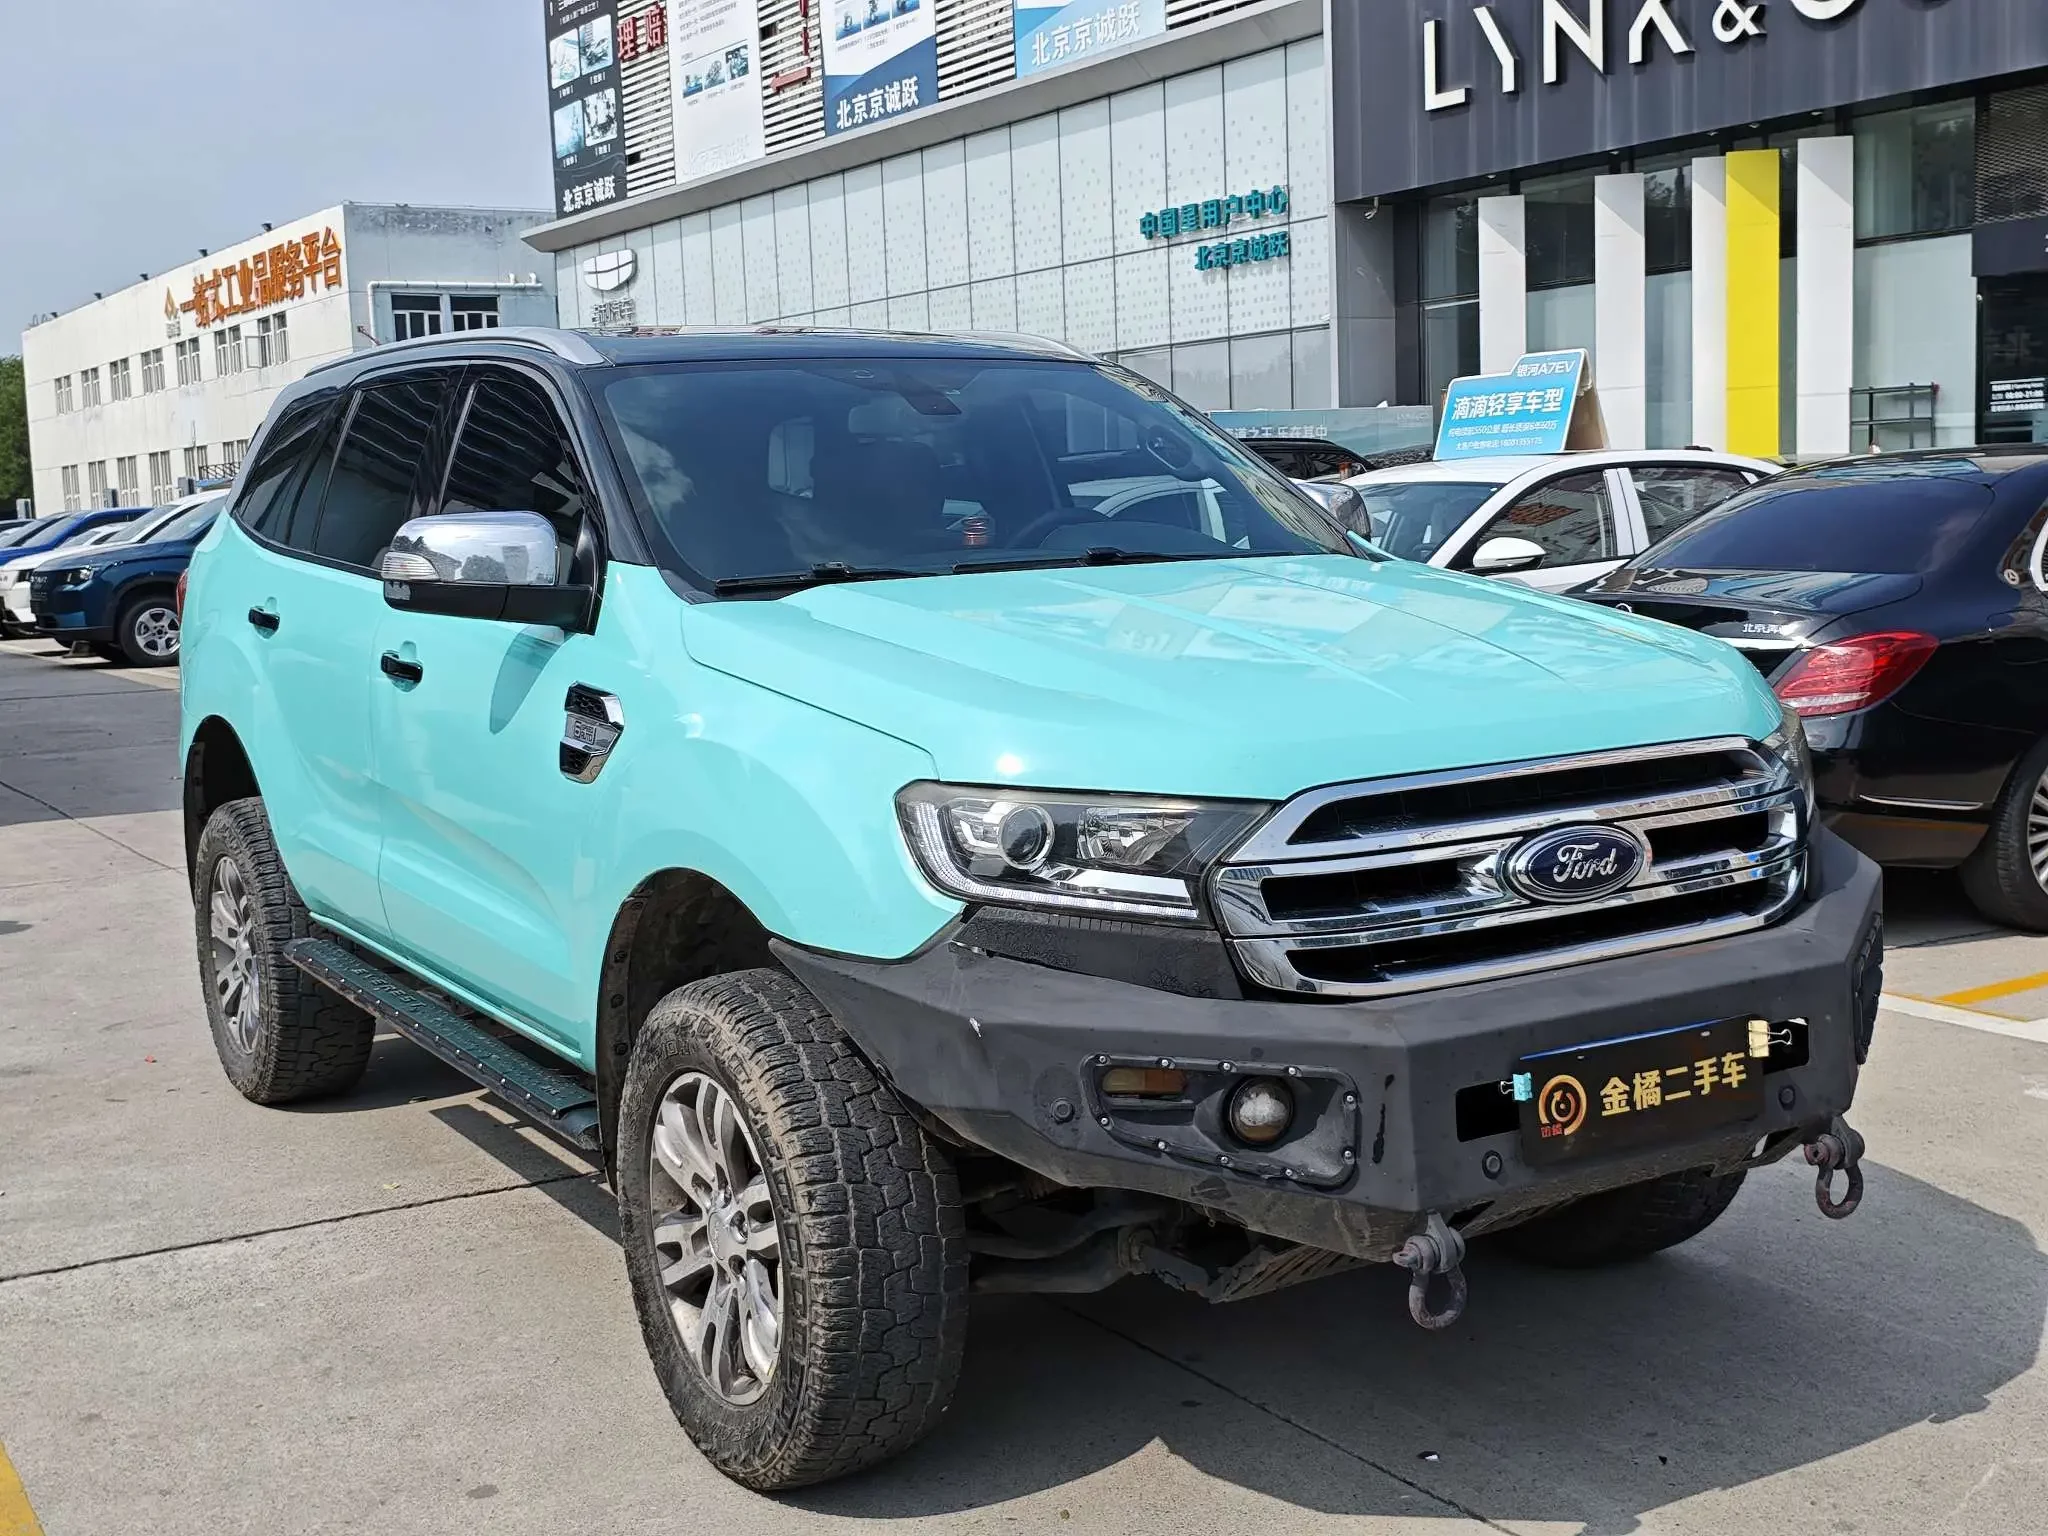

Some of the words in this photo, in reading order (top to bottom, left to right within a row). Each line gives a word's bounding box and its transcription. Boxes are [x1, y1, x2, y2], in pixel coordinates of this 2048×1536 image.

[617, 2, 664, 63] 理赔
[1031, 6, 1140, 66] 北京京诚跃
[836, 75, 919, 130] 北京京诚跃
[563, 175, 615, 213] 北京京诚跃
[1140, 185, 1288, 240] 中国星用户中心
[180, 226, 342, 328] 一站式工业品服务平台
[1195, 231, 1288, 271] 北京京诚跃
[1517, 360, 1576, 377] 银河A7EV
[1452, 387, 1564, 420] 滴滴轻享车型
[1552, 842, 1618, 883] Ford
[1600, 1051, 1747, 1117] 金橘二手车
